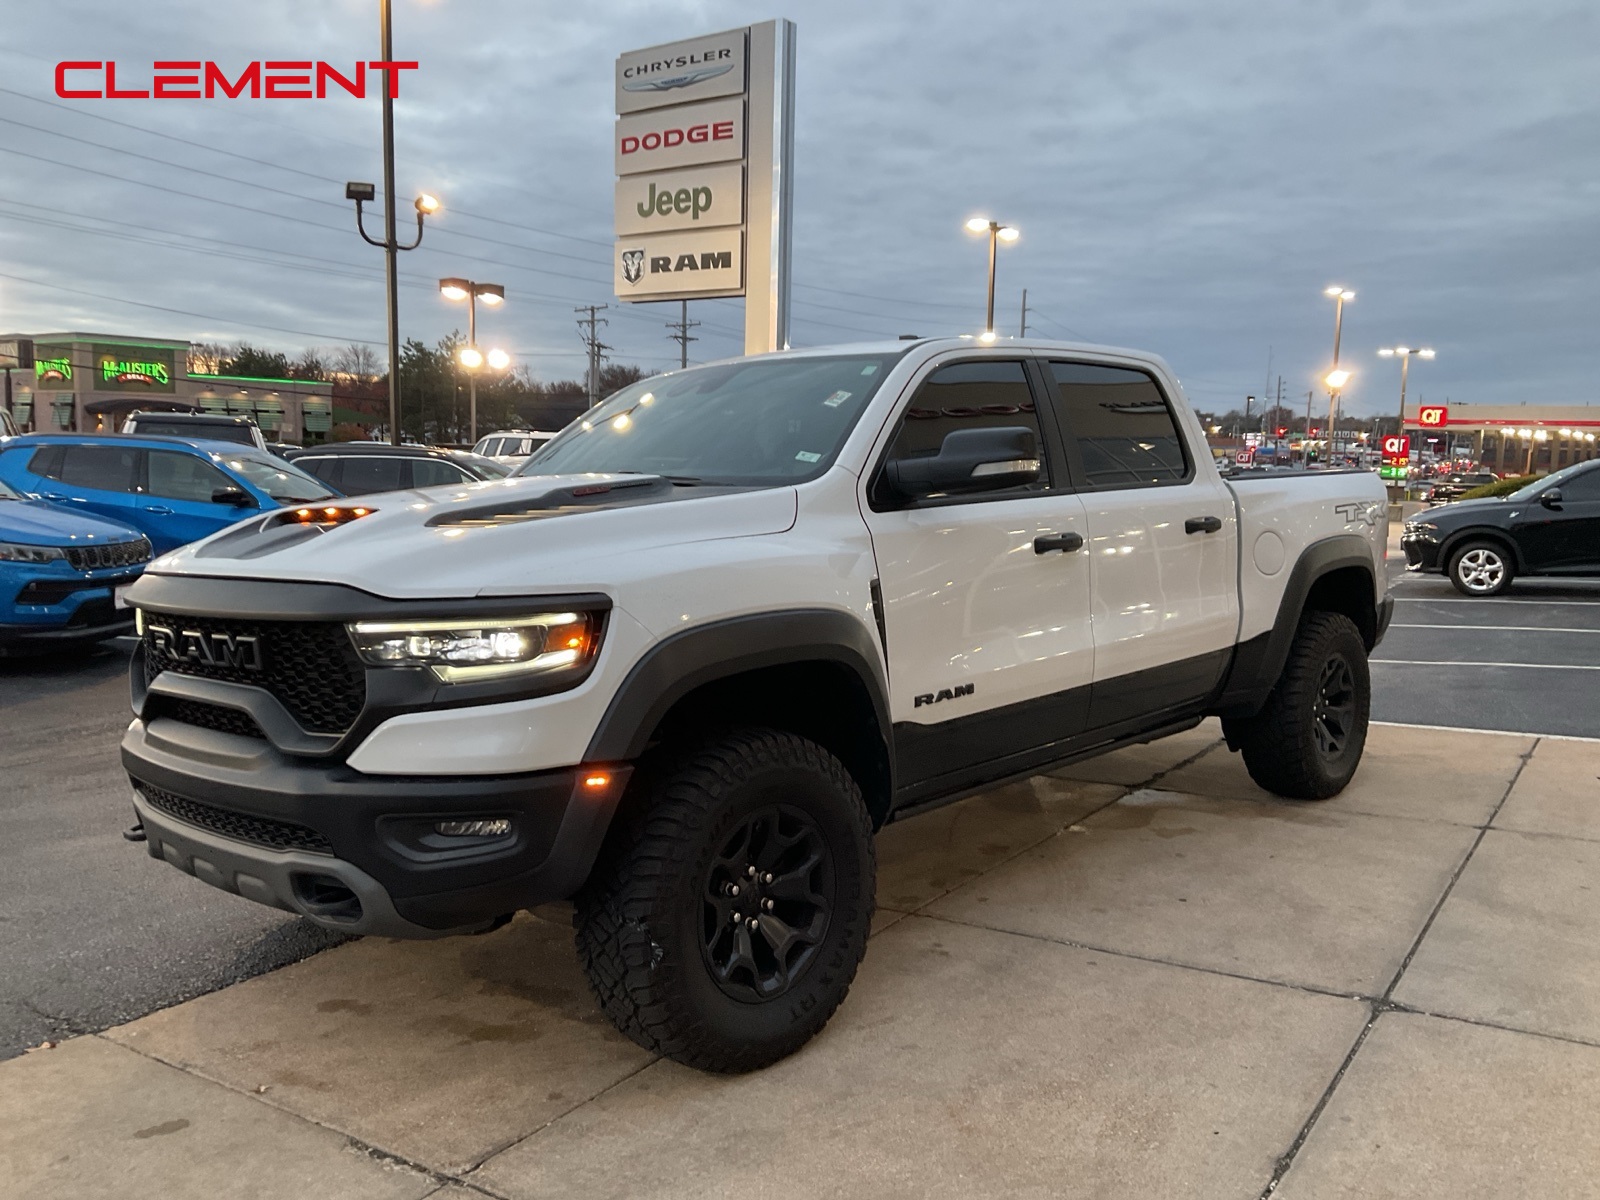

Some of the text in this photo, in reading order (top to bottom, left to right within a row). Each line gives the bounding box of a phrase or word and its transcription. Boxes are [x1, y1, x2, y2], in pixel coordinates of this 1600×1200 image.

[624, 48, 731, 79] CHRYSLER
[621, 120, 734, 155] DODGE
[637, 183, 713, 220] Jeep
[650, 251, 732, 274] RAM
[1421, 408, 1444, 425] QT
[1237, 453, 1250, 462] QT
[1385, 437, 1406, 453] QT
[1334, 500, 1387, 527] TRX
[148, 625, 264, 670] RAM
[914, 682, 975, 709] RAM
